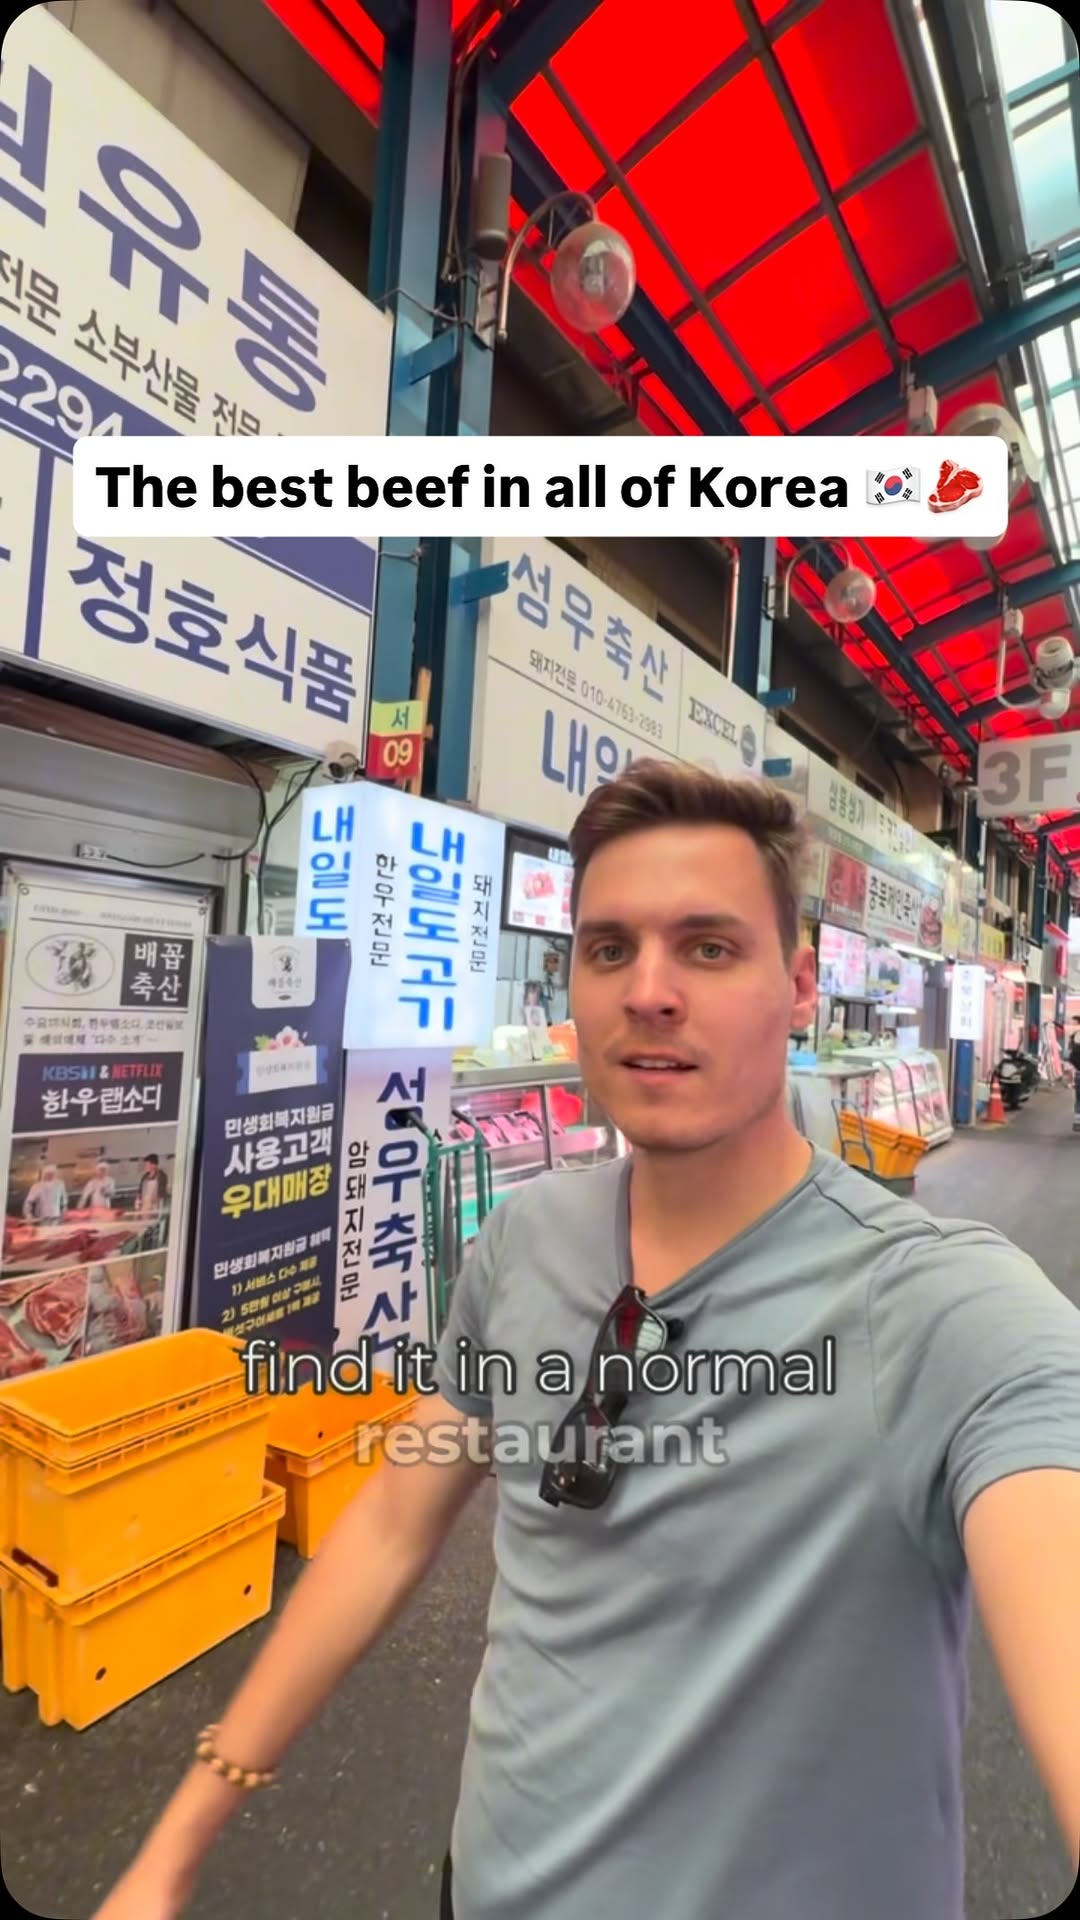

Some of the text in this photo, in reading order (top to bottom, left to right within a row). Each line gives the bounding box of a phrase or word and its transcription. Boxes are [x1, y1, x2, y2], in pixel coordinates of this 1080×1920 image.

[74, 308, 200, 423] 소부산물
[68, 537, 356, 723] 정호식품
[512, 553, 668, 703] 성우축산
[529, 649, 577, 692] 돼지전문
[391, 706, 410, 730] 서
[688, 695, 737, 747] EXCEL
[383, 737, 413, 768] 09
[982, 744, 1072, 806] 3F
[306, 805, 354, 930] 내일도
[370, 853, 398, 967] 한우전문
[398, 821, 466, 1031] 내일도고기
[469, 873, 494, 973] 돼지전문
[134, 941, 185, 971] 배꼽
[130, 971, 182, 1003] 축산
[99, 1064, 110, 1080] &
[111, 1062, 163, 1080] NETFLIX
[41, 1083, 163, 1120] 한우랩소디
[224, 1102, 335, 1139] 민생회복지원금
[224, 1126, 333, 1177] 사용고객
[220, 1163, 333, 1219] 우대매장
[340, 1140, 370, 1303] 암돼지전문
[214, 1235, 307, 1280] 민생회복지원금
